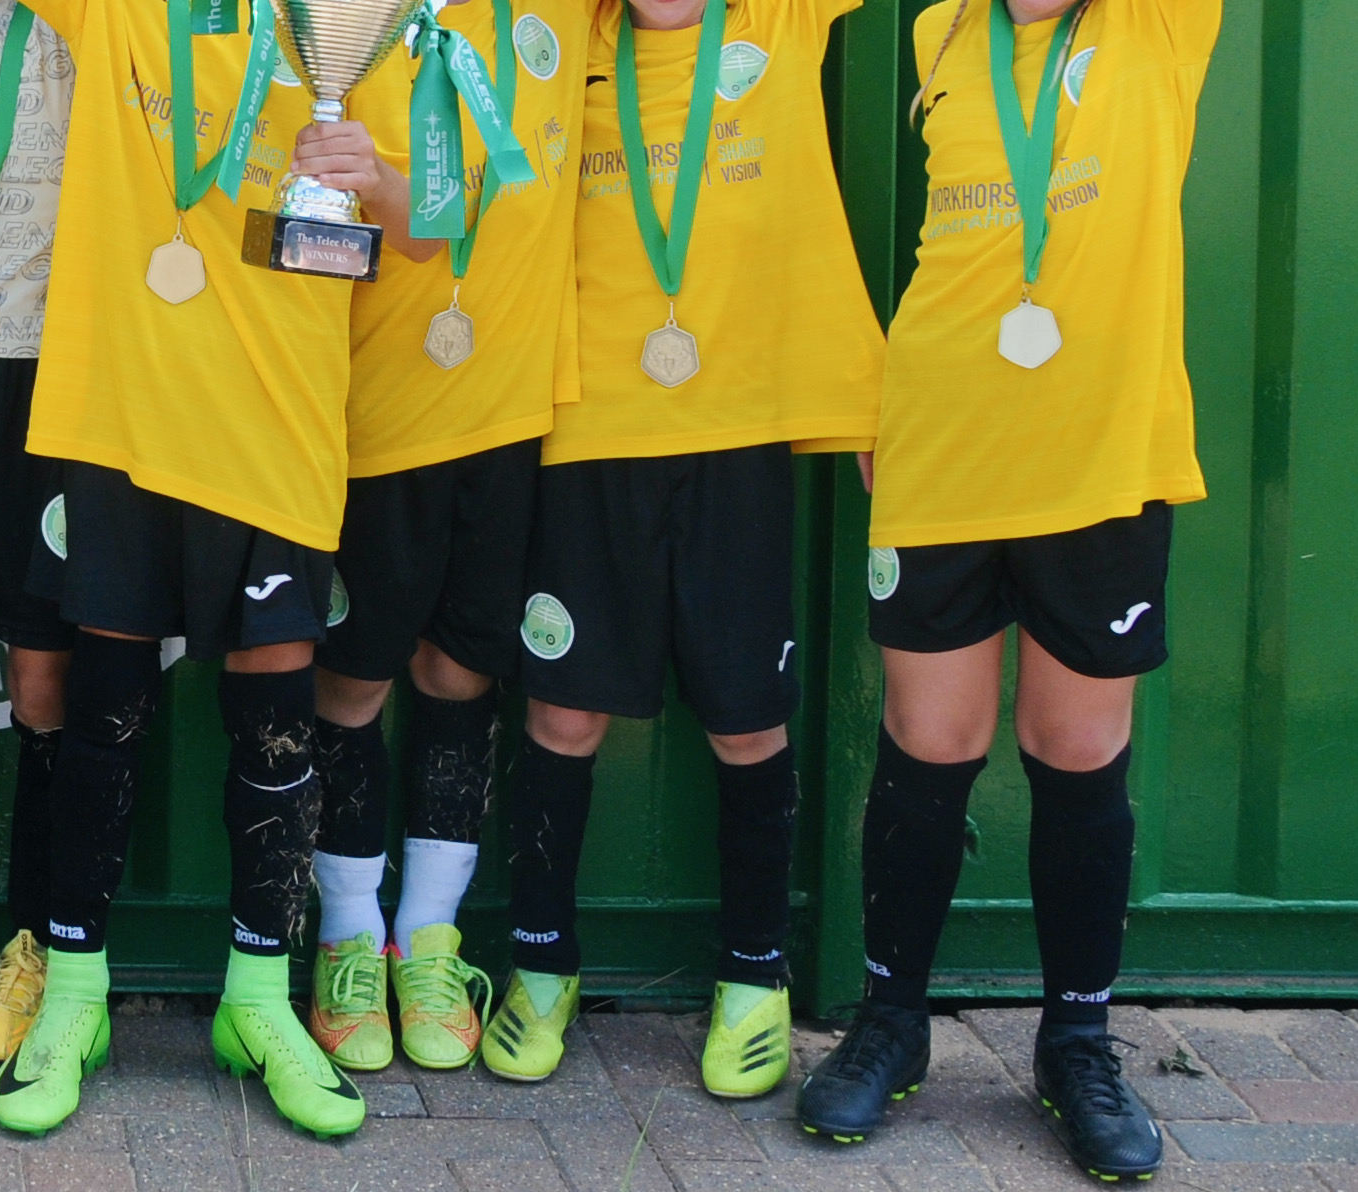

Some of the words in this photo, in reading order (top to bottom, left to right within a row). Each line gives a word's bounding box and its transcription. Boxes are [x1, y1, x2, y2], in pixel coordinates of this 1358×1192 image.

[461, 46, 497, 112] TELEC
[235, 121, 251, 161] Cup
[254, 119, 270, 139] NE
[714, 119, 742, 140] ONE
[717, 137, 766, 163] SHARED
[242, 162, 273, 188] SION
[426, 130, 441, 205] TELEC
[721, 161, 763, 184] VISION
[1046, 181, 1100, 214] VISION
[297, 232, 313, 244] The
[342, 238, 360, 251] Cup
[304, 249, 348, 264] WINNERS
